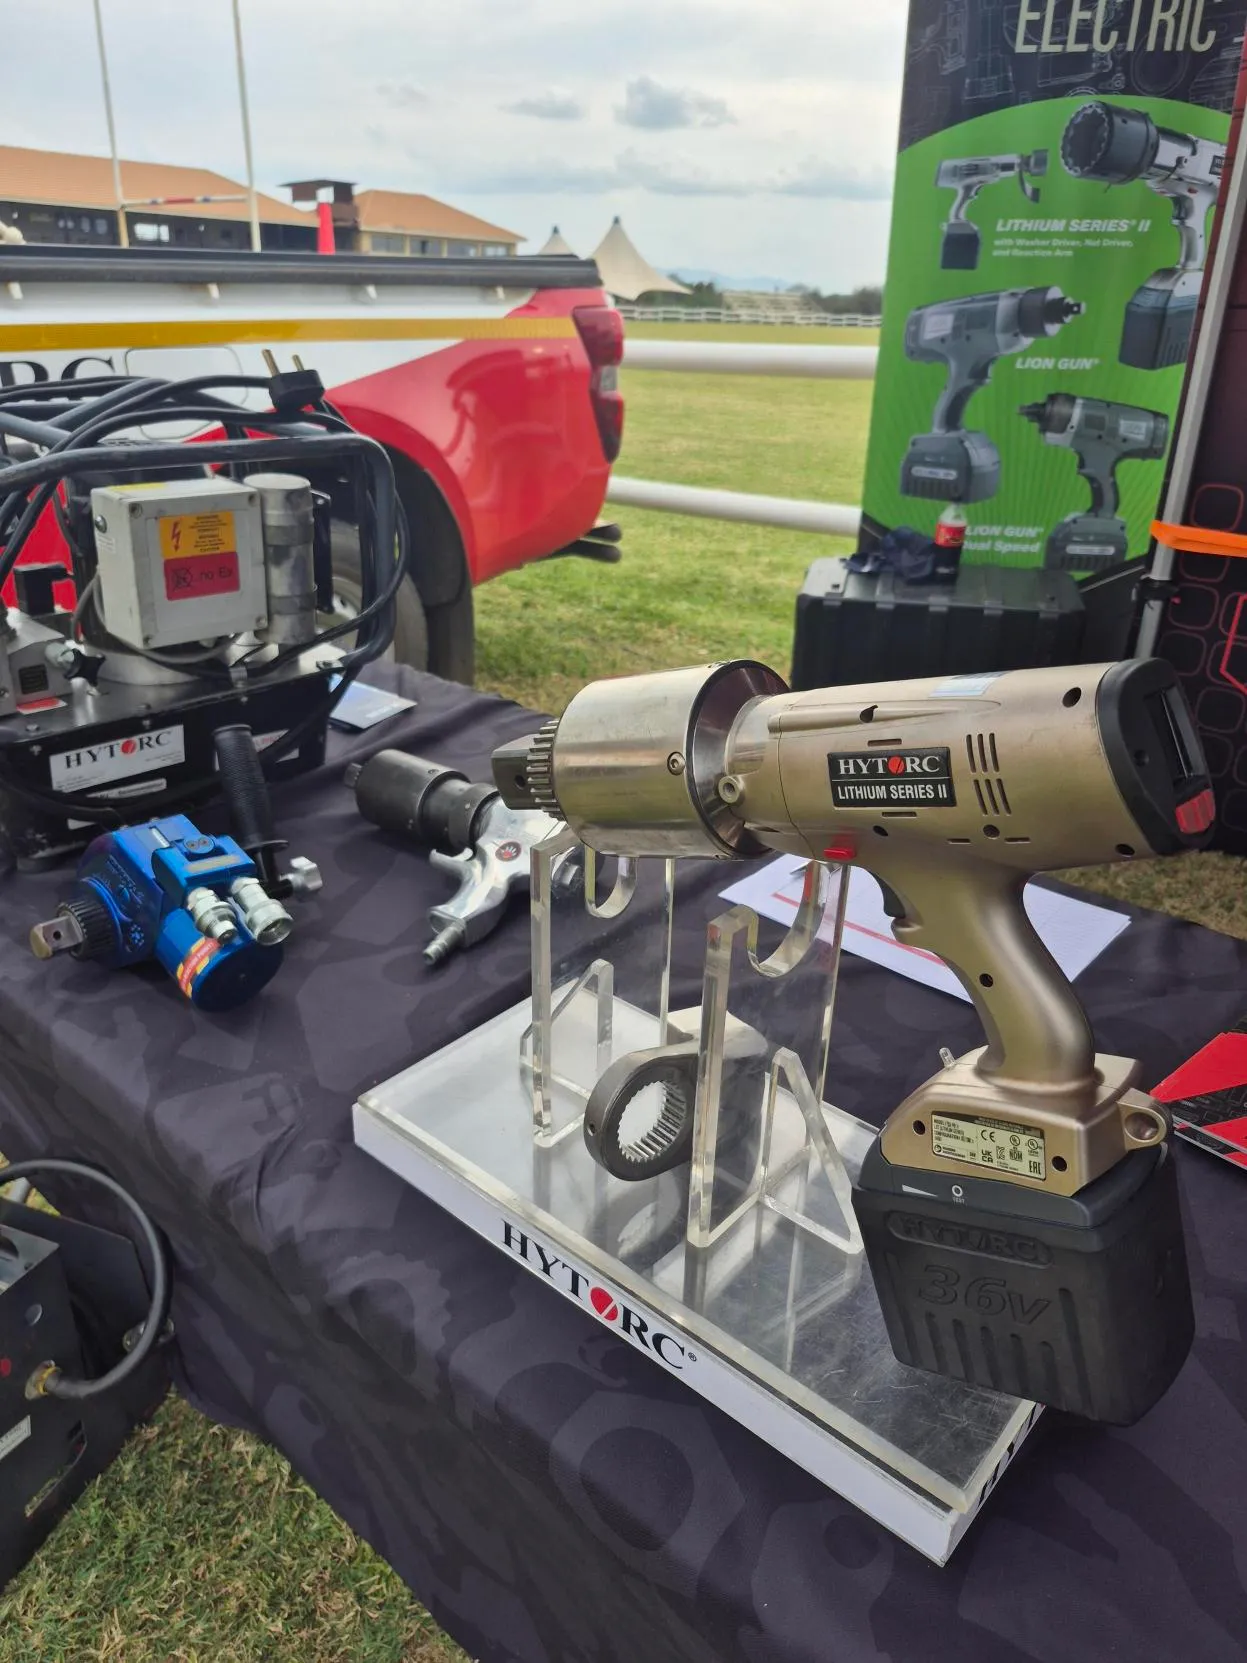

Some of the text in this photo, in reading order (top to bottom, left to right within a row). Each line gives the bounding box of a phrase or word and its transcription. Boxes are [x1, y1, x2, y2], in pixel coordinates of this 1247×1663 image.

[1014, 0, 1218, 53] ELECTRIC
[995, 219, 1066, 232] LITHIUM
[1138, 219, 1152, 232] II
[993, 238, 1013, 246] with
[1016, 238, 1050, 246] Washer
[1012, 249, 1052, 257] Reaction
[1015, 356, 1055, 369] LION
[965, 526, 1000, 536] LION
[963, 541, 1041, 553] ual Speed
[65, 731, 172, 769] HYTORC
[838, 755, 940, 776] HYTORC
[838, 783, 948, 800] LITHIUM SERIES II
[980, 1129, 996, 1143] CE
